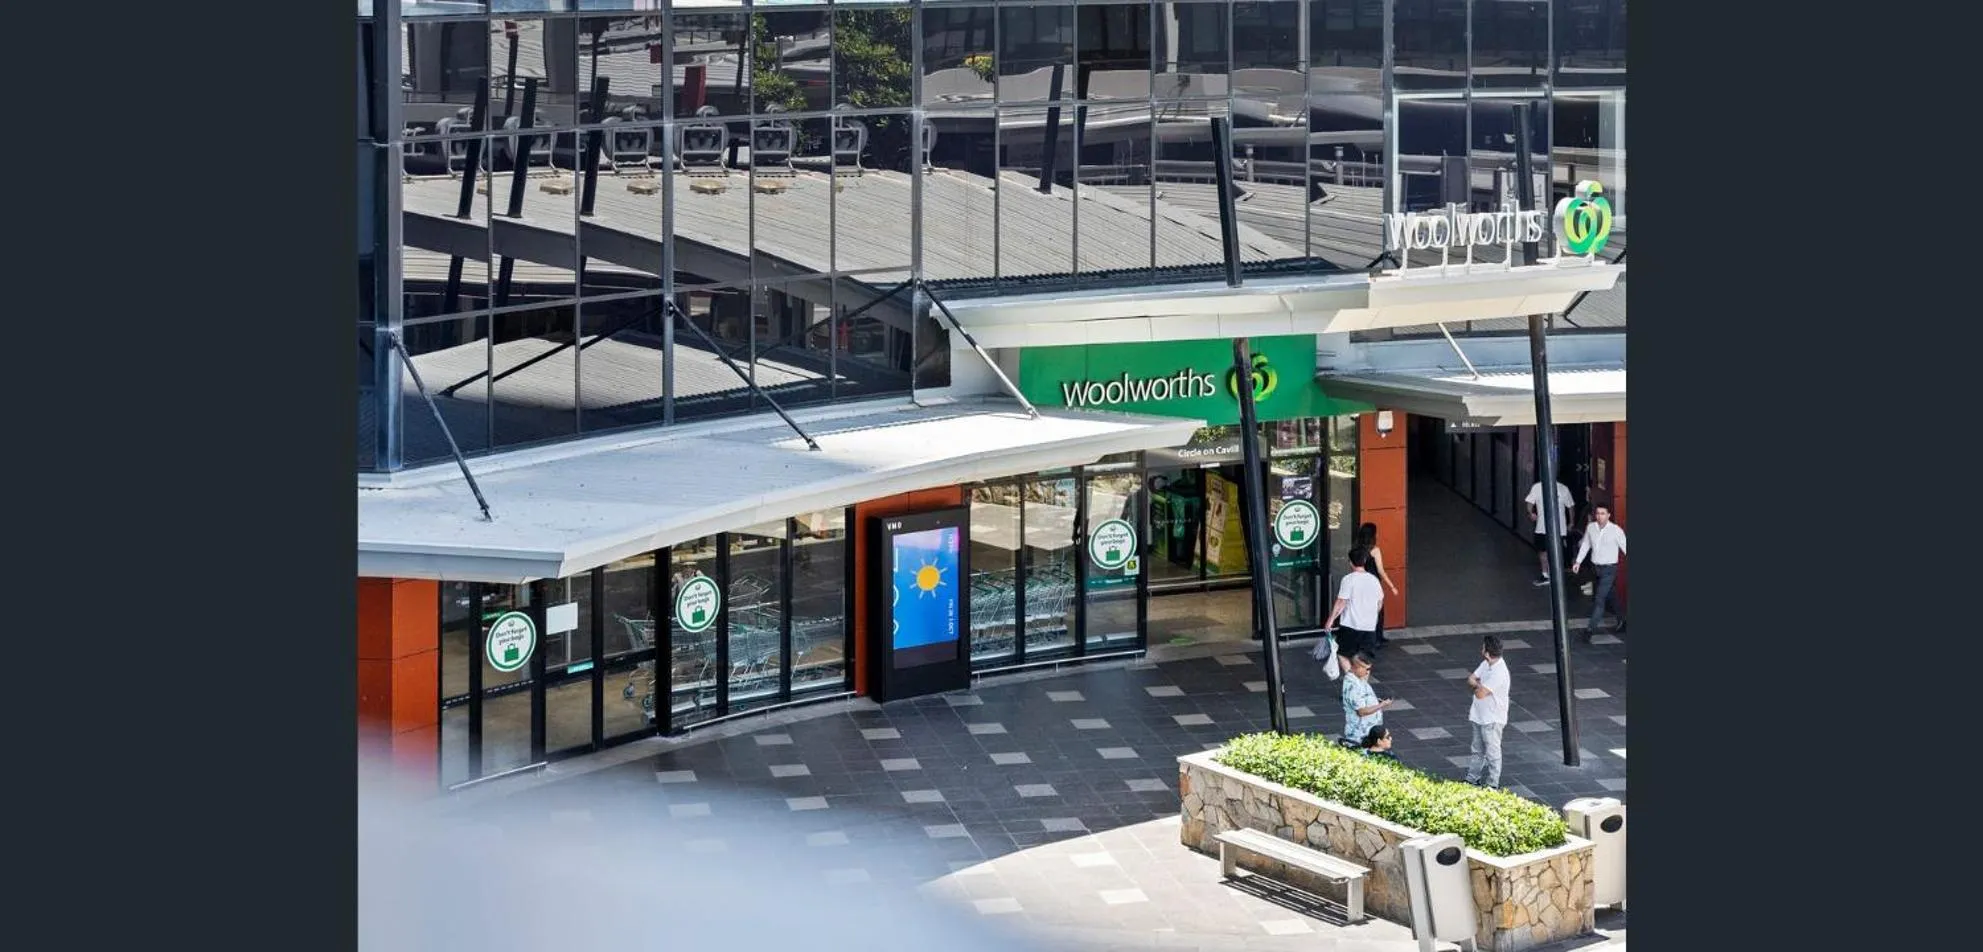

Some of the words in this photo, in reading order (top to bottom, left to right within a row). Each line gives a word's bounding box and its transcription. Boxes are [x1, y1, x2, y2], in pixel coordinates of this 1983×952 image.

[1387, 200, 1543, 251] Woolworths
[1063, 368, 1217, 407] Woolworths
[1178, 447, 1201, 458] Circle
[1203, 448, 1214, 456] on
